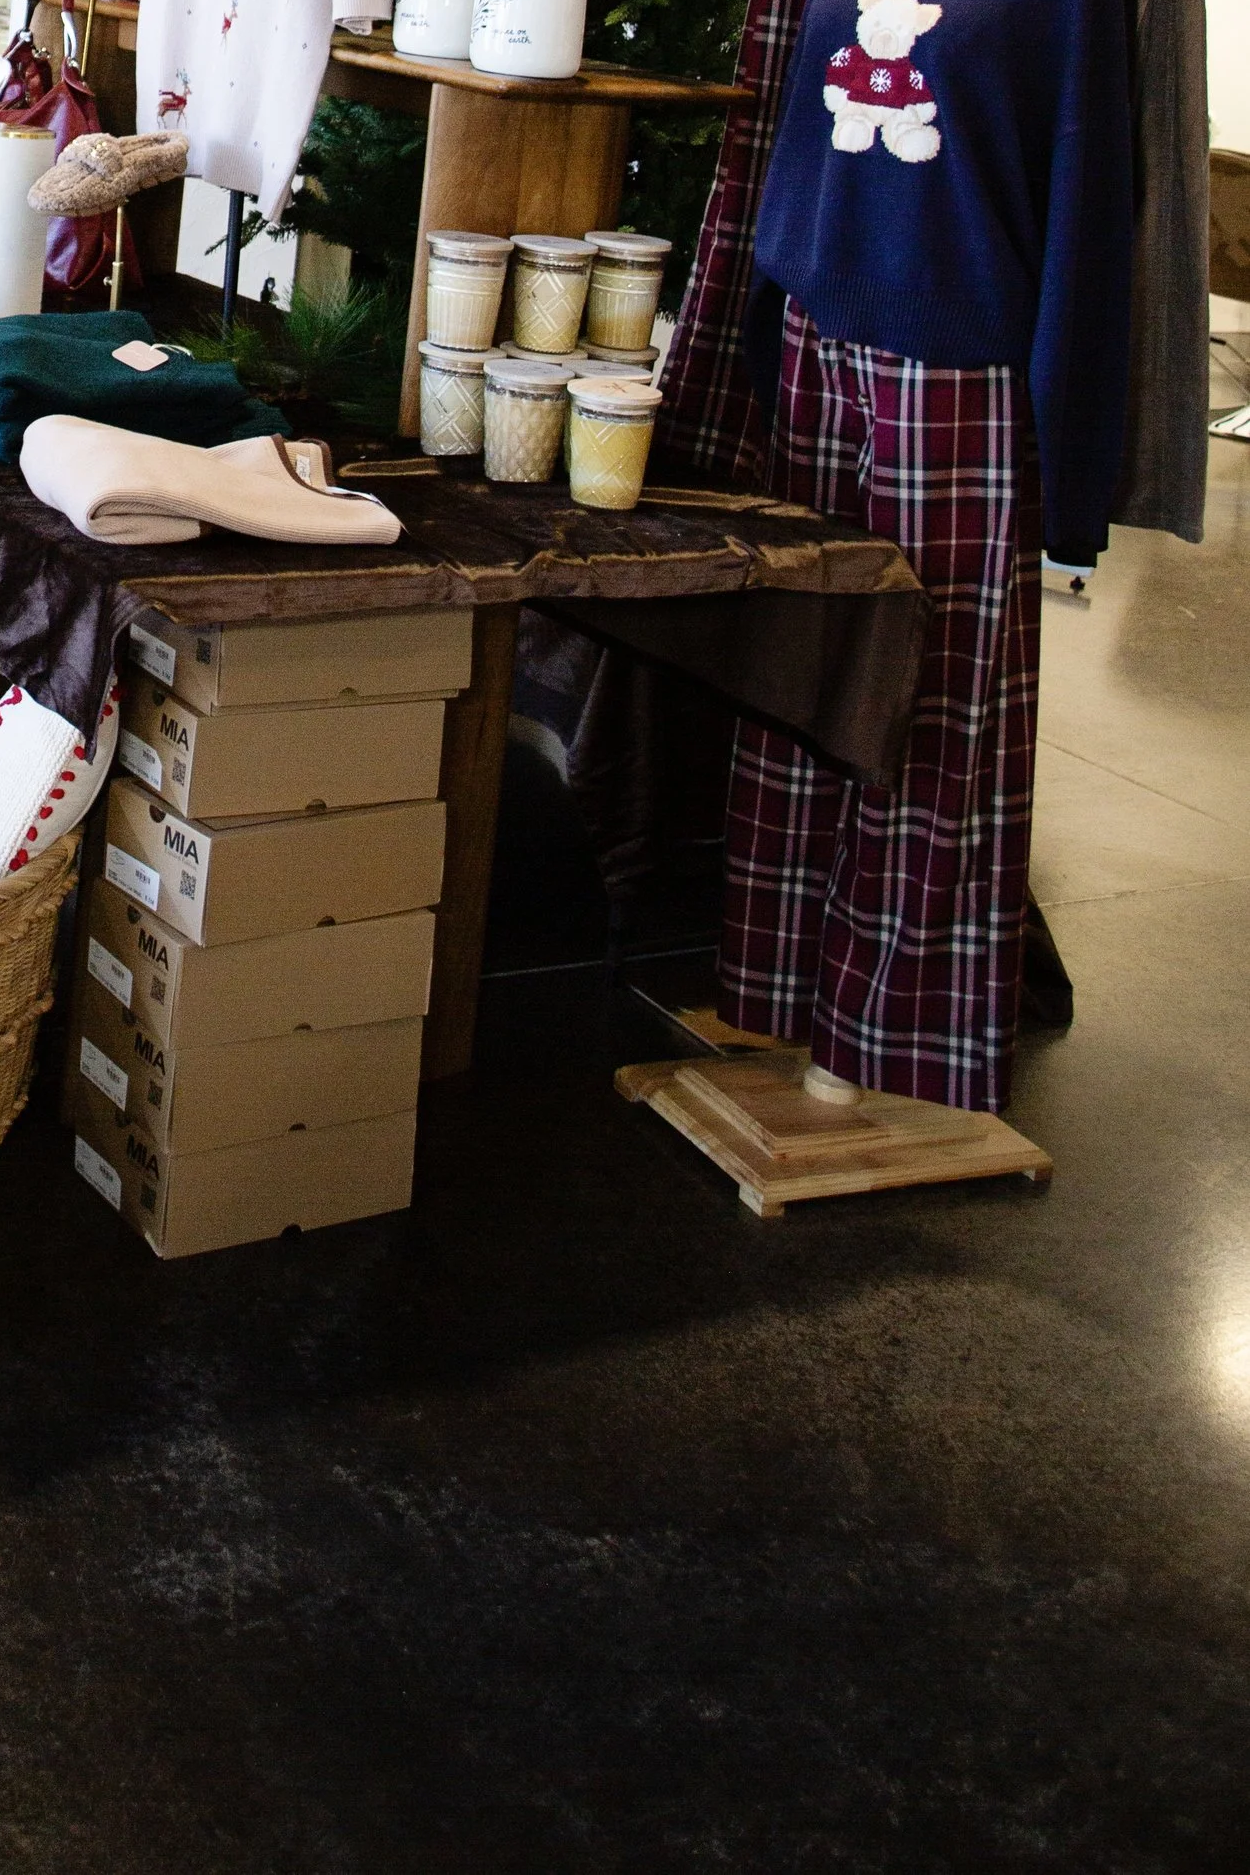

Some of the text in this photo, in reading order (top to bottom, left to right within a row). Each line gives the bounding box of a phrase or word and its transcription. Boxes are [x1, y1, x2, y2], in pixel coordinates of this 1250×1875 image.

[159, 712, 189, 752] MIA
[163, 824, 199, 865] MIA
[138, 927, 169, 971] MIA
[134, 1031, 166, 1076] MIA
[126, 1134, 160, 1180] MIA
